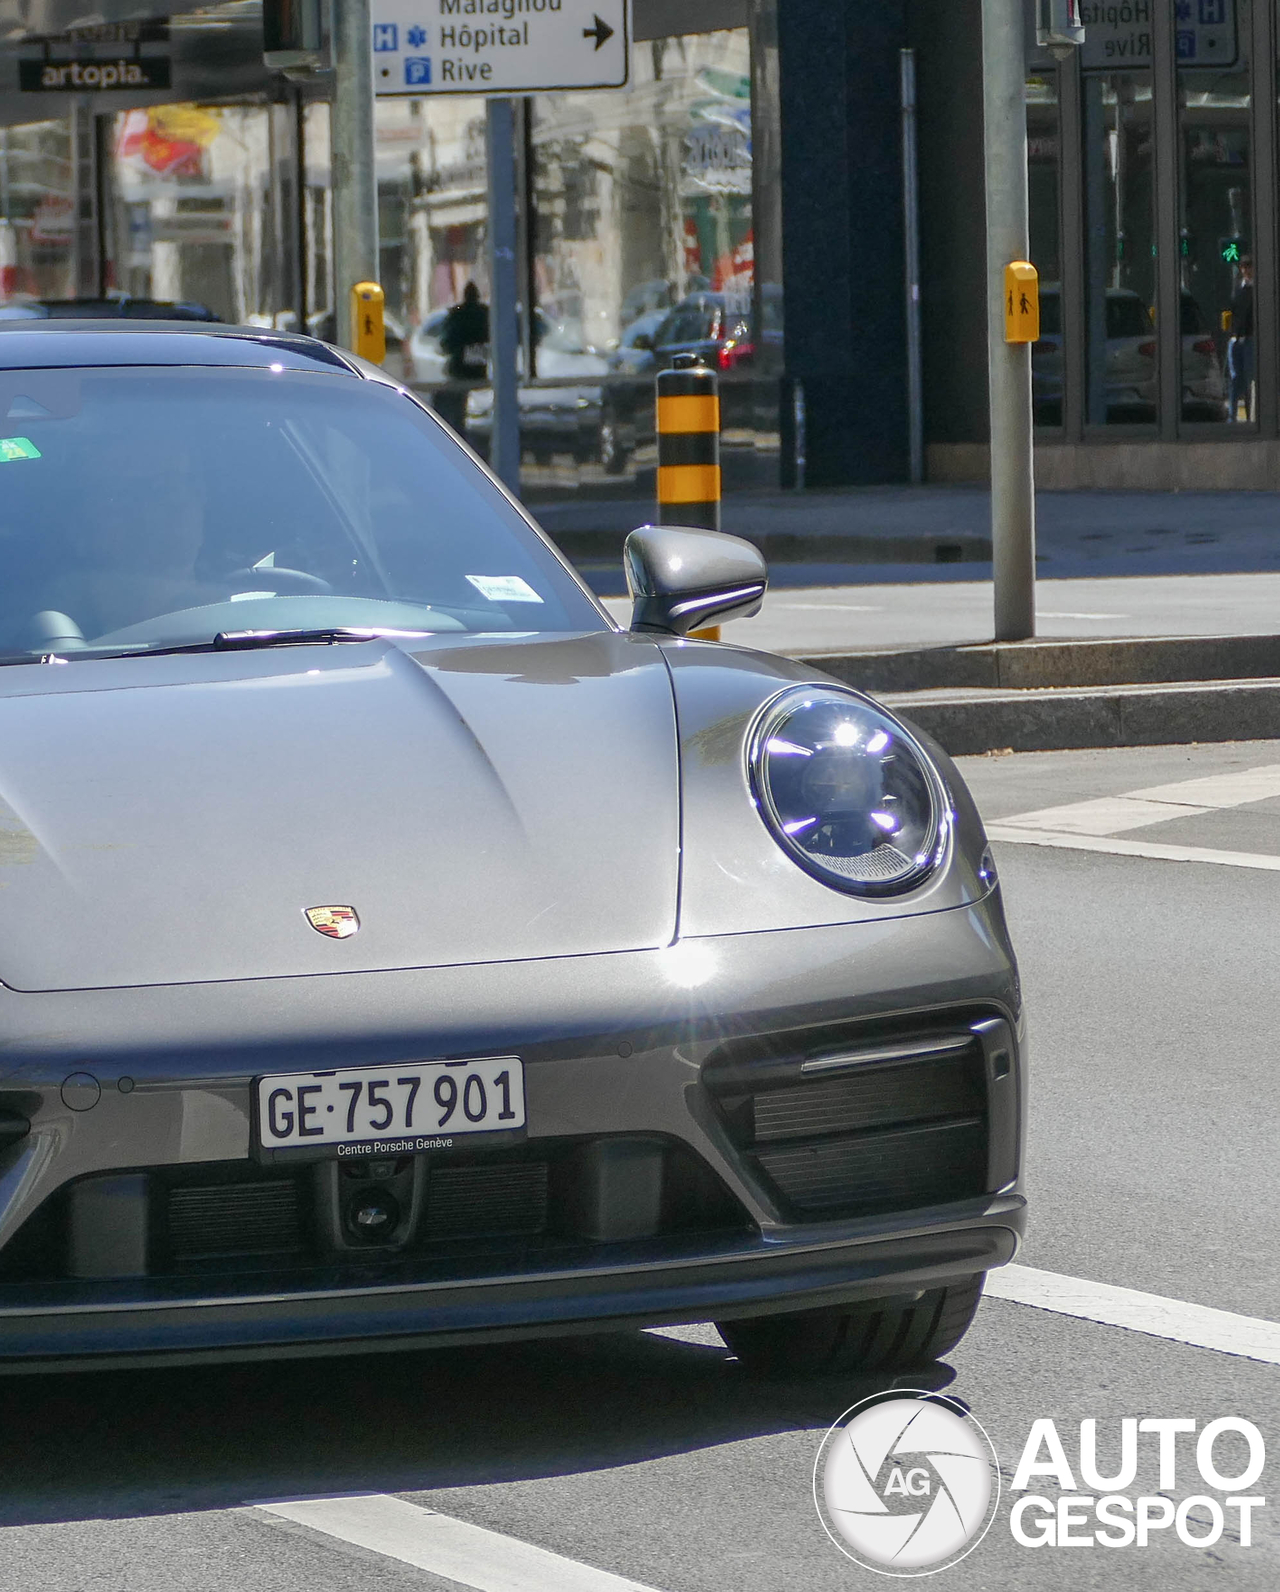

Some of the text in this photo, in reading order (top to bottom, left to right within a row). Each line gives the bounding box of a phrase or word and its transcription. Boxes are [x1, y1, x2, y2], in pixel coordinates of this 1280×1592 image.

[441, 22, 529, 52] Hôpital
[442, 58, 493, 81] Rive
[434, 1070, 515, 1128] 901
[337, 1136, 453, 1156] Centre Porsche Genève
